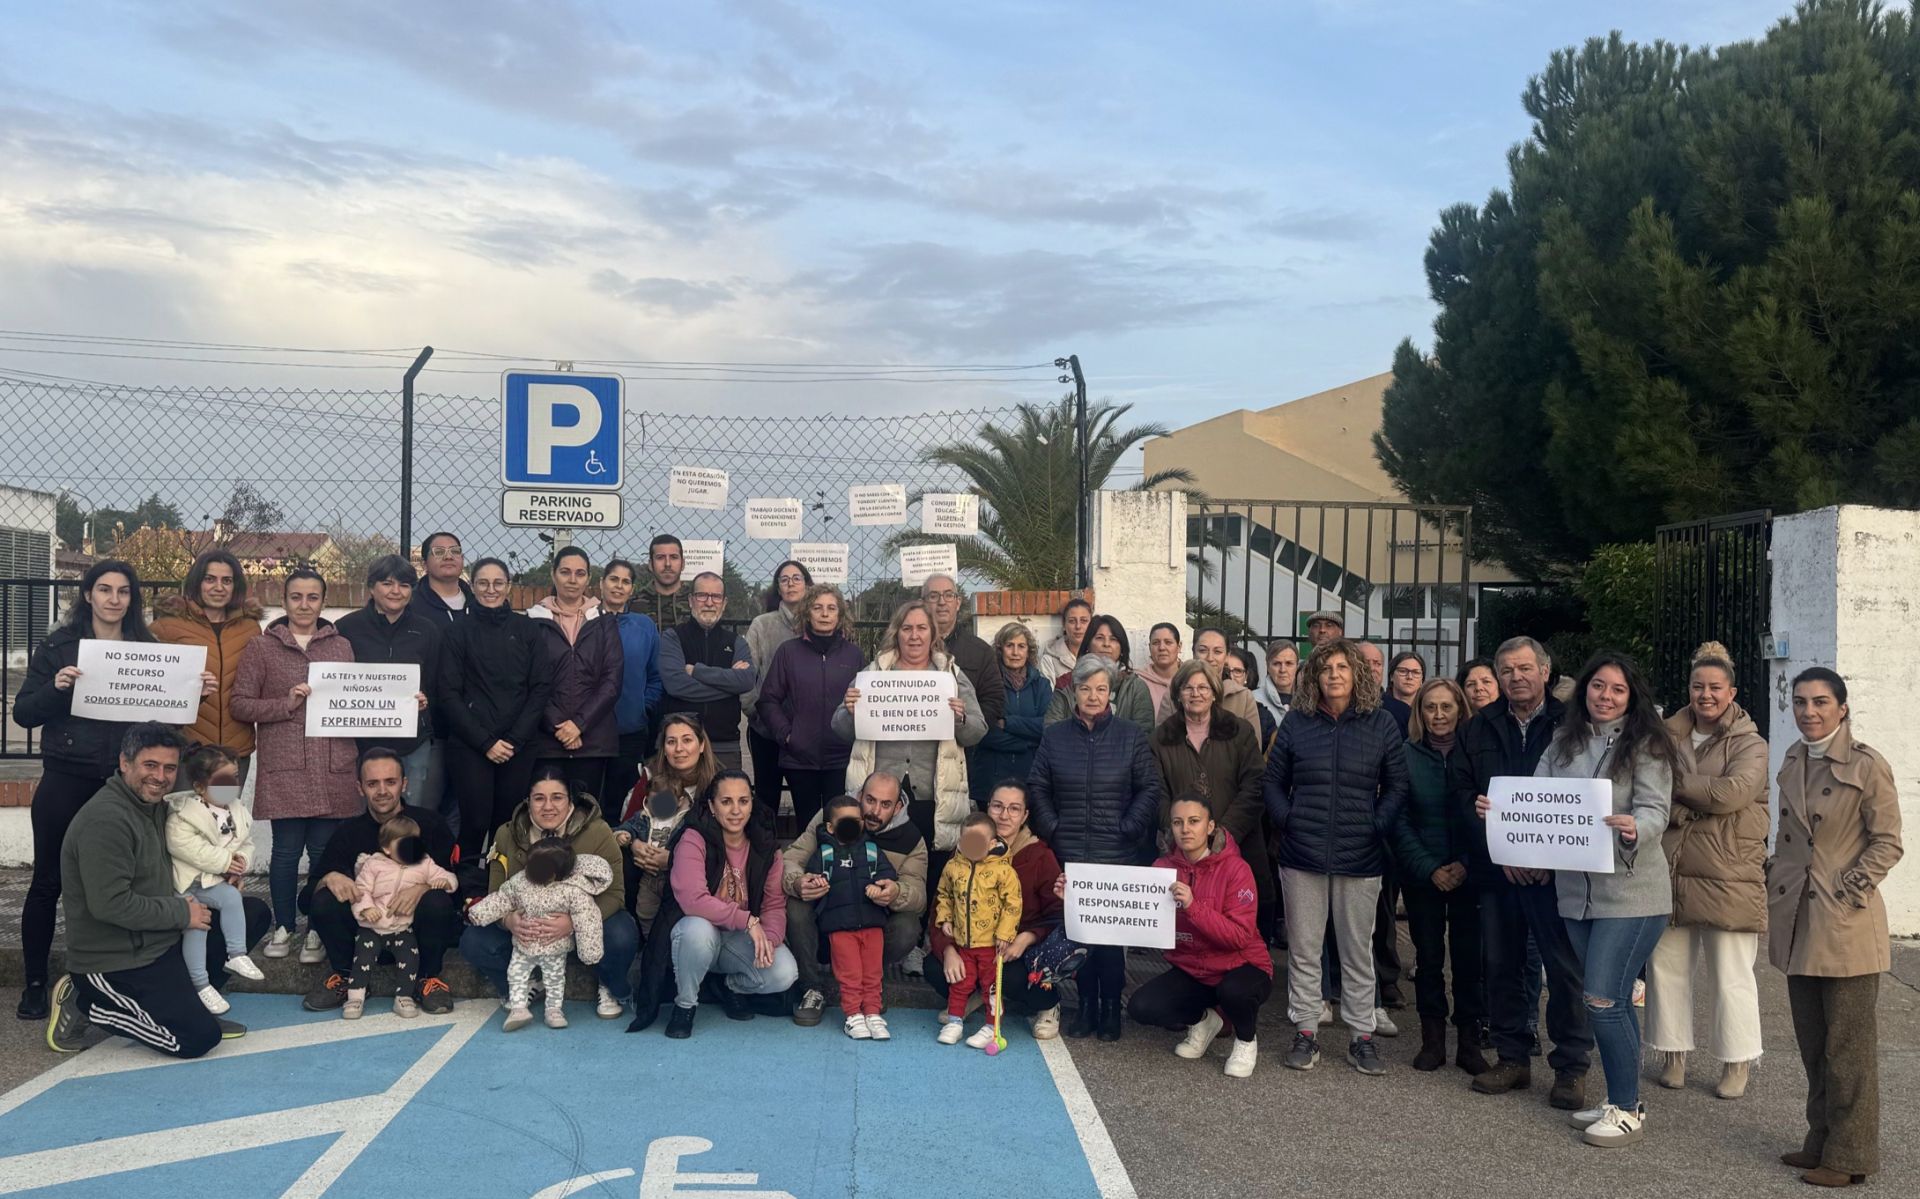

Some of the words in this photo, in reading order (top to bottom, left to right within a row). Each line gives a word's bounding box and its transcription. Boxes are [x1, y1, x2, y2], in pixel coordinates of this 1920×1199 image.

[527, 383, 602, 475] P
[530, 495, 592, 508] PARKING
[520, 510, 604, 522] RESERVADO
[124, 653, 162, 662] SOMOS
[118, 668, 165, 677] RECURSO
[109, 682, 166, 693] TEMPORAL,
[84, 696, 120, 705] SOMOS
[123, 697, 188, 708] EDUCADORAS
[329, 699, 347, 709] NO
[351, 700, 375, 709] SON
[379, 700, 395, 710] UN
[321, 717, 402, 728] EXPERIMENTO
[1512, 792, 1533, 803] ¡NO
[1537, 793, 1581, 804] SOMOS
[1501, 812, 1574, 824] MONIGOTES
[1578, 815, 1593, 825] DE
[1507, 832, 1544, 844] QUITA
[1547, 834, 1554, 844] Y
[1558, 835, 1588, 846] PON!
[1073, 881, 1093, 889] POR
[1096, 882, 1118, 891] UNA
[1122, 883, 1166, 894] GESTIÓN
[1079, 898, 1150, 910] RESPONSABLE
[1080, 914, 1158, 928] TRANSPARENTE
